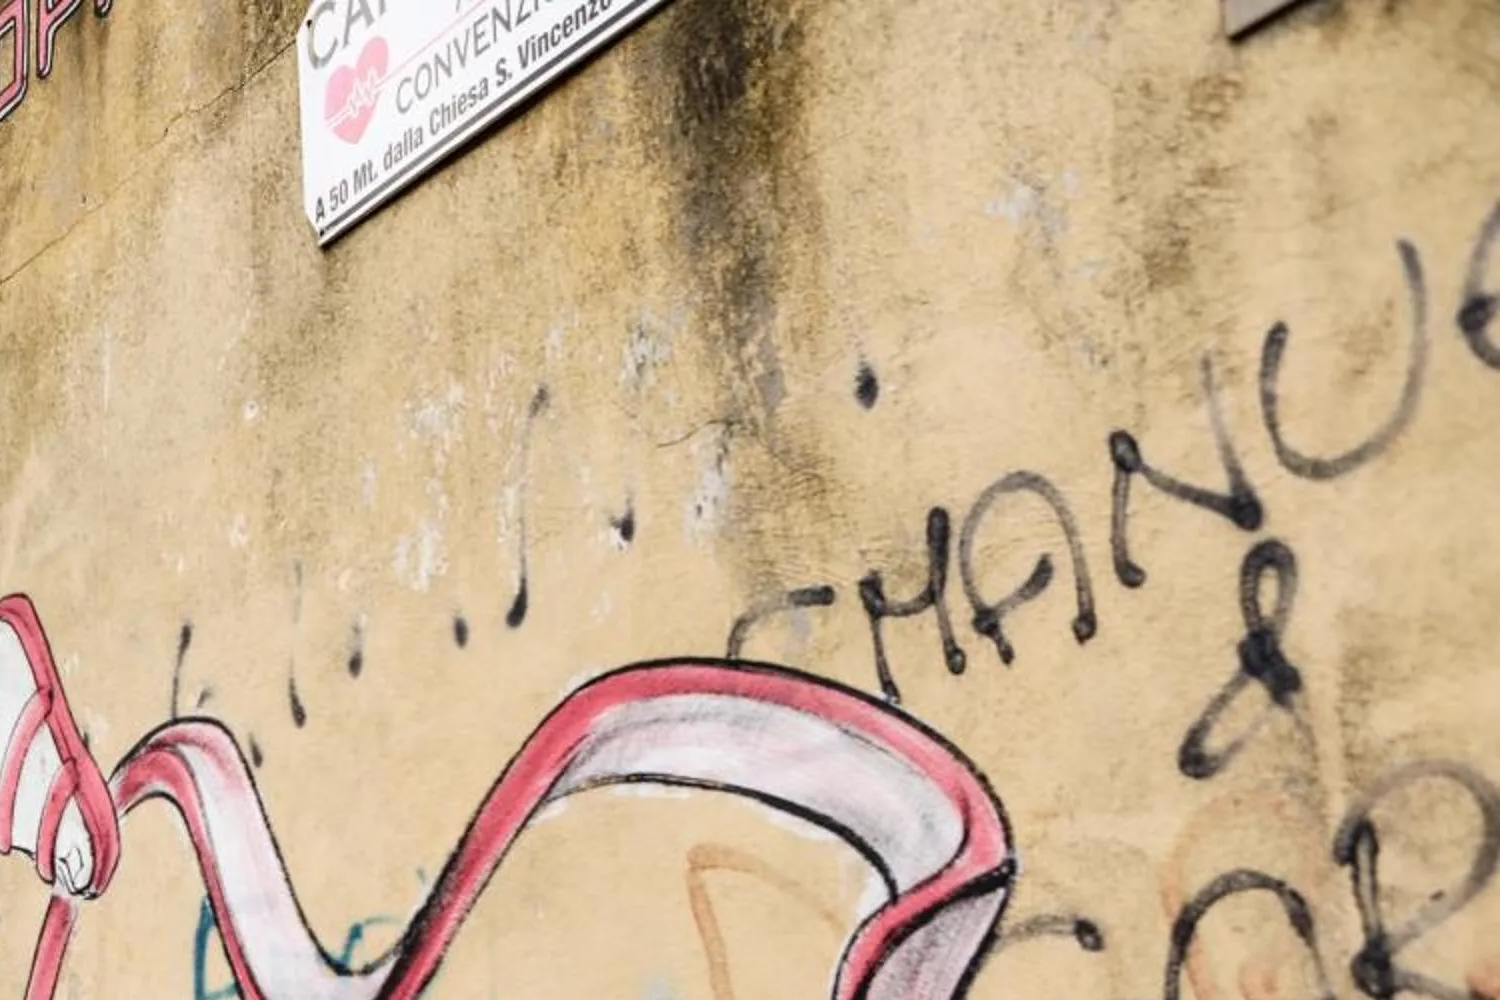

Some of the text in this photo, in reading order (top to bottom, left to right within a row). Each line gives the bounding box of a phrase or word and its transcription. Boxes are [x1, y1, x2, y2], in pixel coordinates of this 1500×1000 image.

[307, 0, 387, 70] CA
[395, 0, 556, 114] CONVENZ
[315, 197, 326, 223] A
[329, 178, 349, 212] 50
[353, 159, 378, 195] Mt.
[383, 126, 425, 171] dalla
[429, 76, 490, 136] Chiesa
[494, 57, 513, 88] S.
